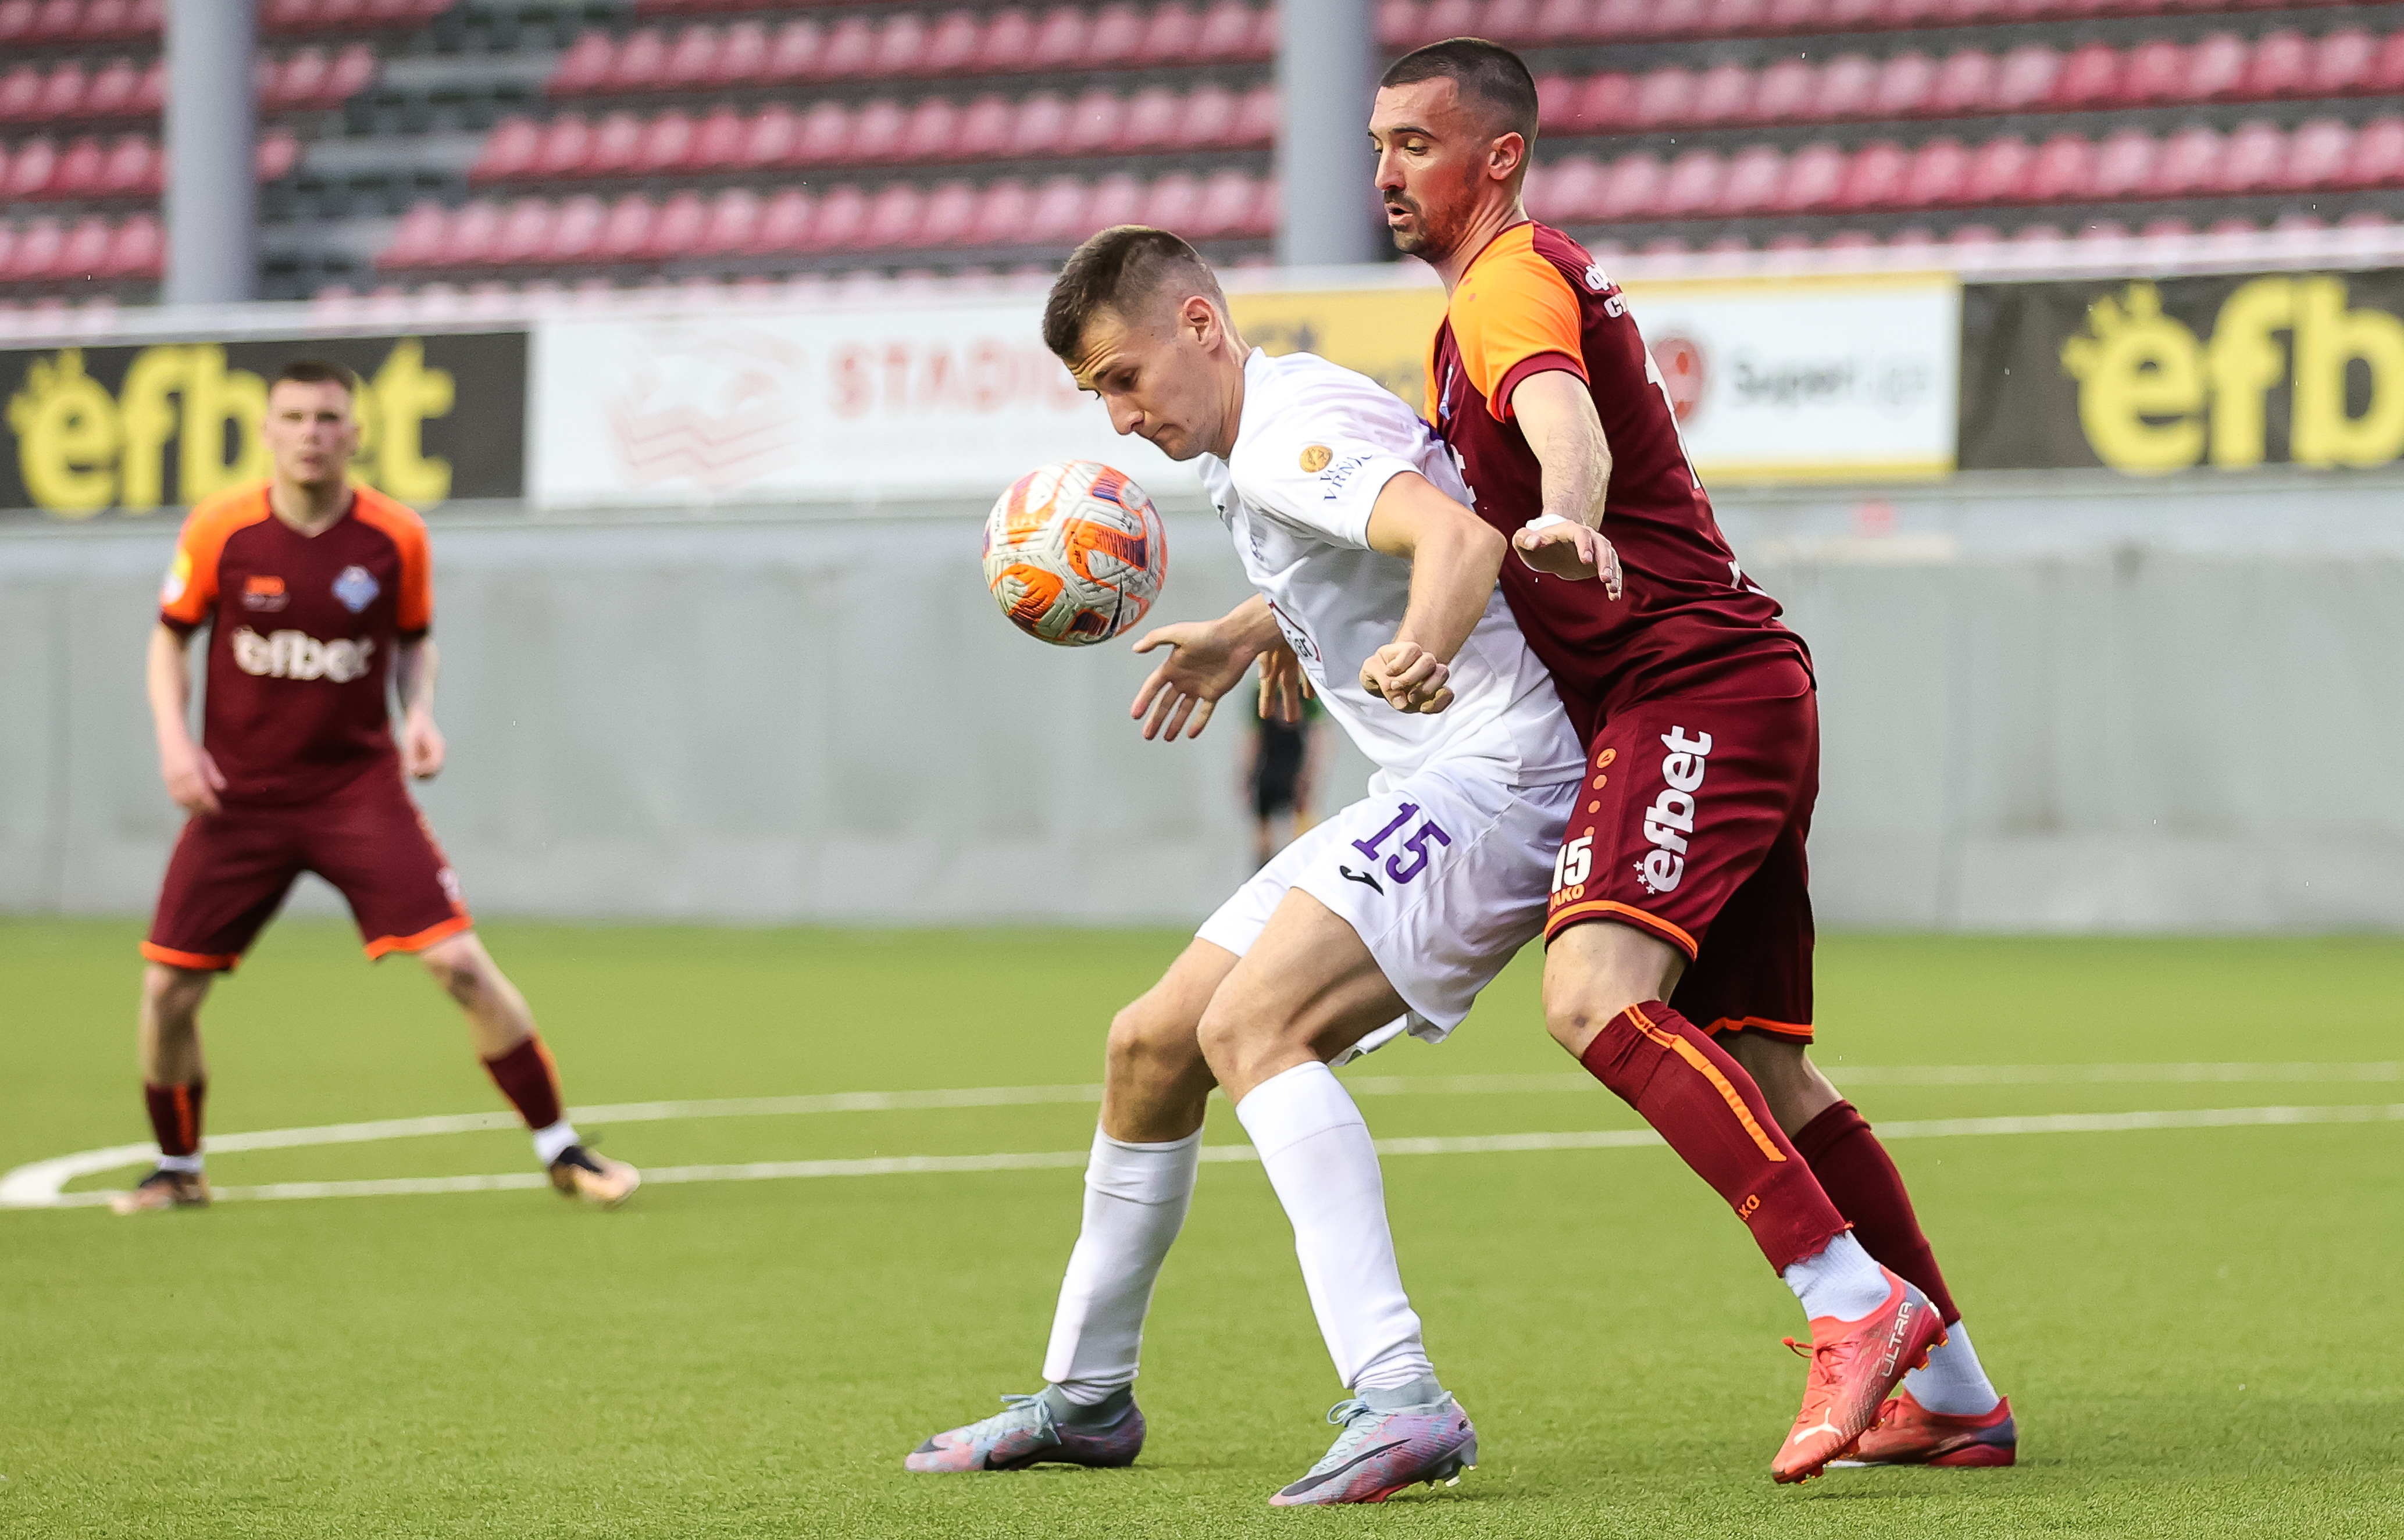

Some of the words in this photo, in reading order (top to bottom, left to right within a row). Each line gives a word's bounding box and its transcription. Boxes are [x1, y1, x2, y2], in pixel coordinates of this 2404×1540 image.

[14, 338, 456, 516] efbt
[1351, 802, 1451, 884] 15
[1635, 725, 1713, 894] efbet
[1551, 836, 1593, 894] 15
[1739, 1194, 1760, 1221] KO
[1879, 1301, 1913, 1378] ULTRA
